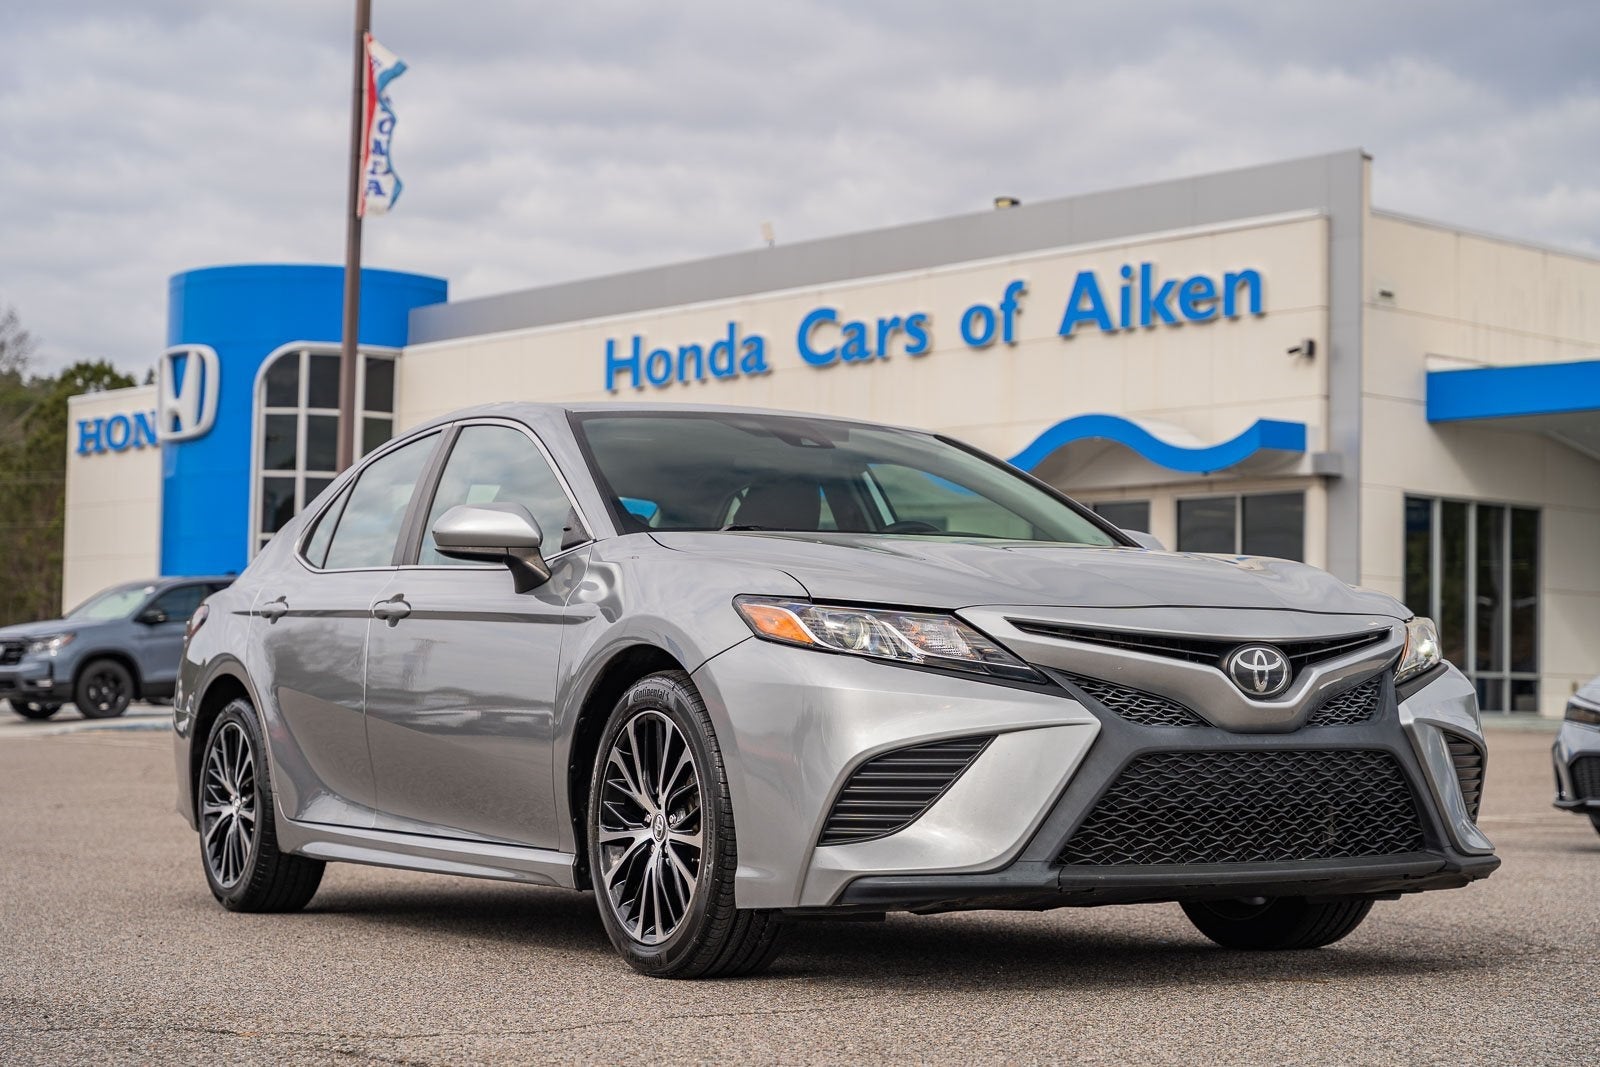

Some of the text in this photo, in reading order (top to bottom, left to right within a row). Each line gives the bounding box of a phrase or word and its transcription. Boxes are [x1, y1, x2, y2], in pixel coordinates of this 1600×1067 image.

[605, 262, 1262, 391] Honda Cars of Aiken
[632, 687, 667, 703] Continental
